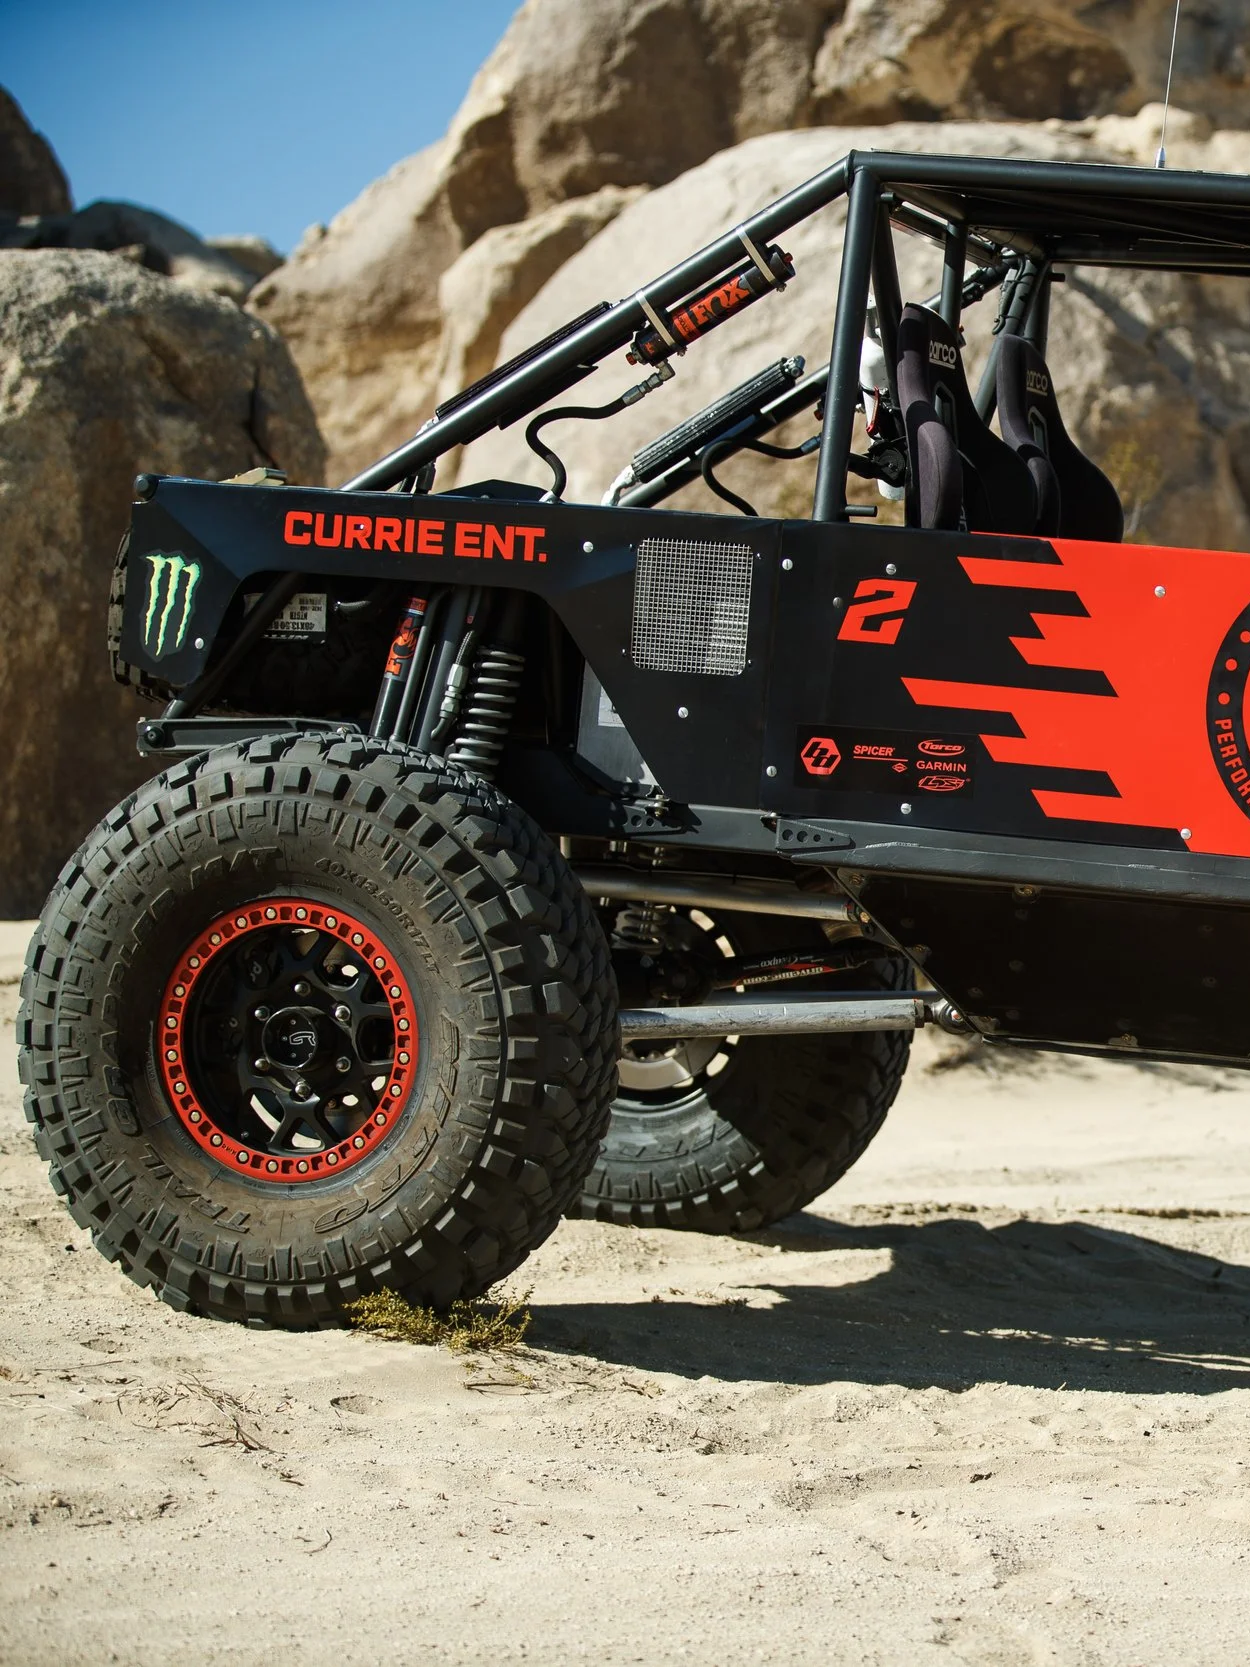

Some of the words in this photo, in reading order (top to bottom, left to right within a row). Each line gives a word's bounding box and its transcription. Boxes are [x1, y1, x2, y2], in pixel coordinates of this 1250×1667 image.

[929, 340, 957, 365] parco
[284, 510, 445, 555] CURRIE
[454, 521, 547, 564] ENT.
[837, 578, 918, 645] 2
[853, 744, 894, 757] SPICER
[923, 742, 962, 751] Torco
[916, 760, 967, 773] GARMIN
